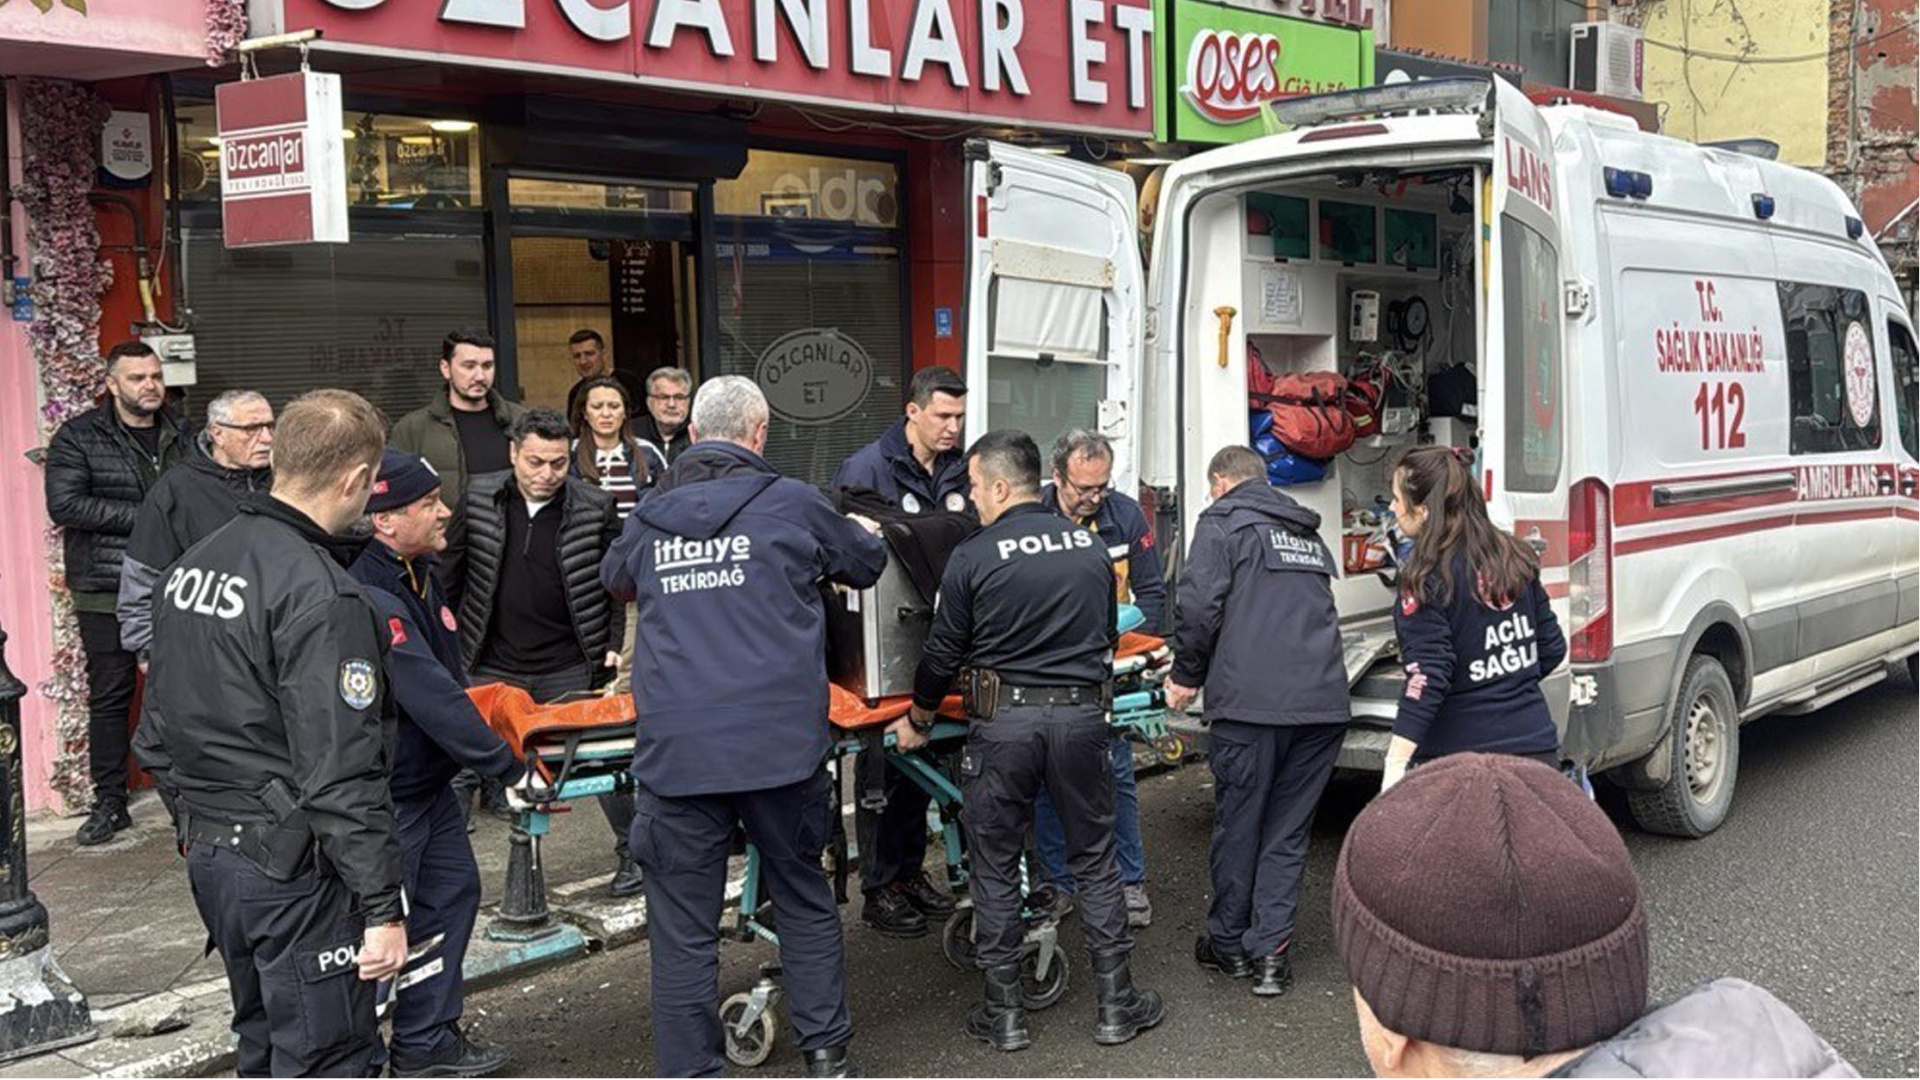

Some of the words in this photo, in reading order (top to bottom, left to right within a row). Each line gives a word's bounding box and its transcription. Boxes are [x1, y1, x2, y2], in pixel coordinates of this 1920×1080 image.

[1070, 0, 1153, 108] ET
[226, 136, 302, 175] özcanlar
[1505, 136, 1552, 211] LANS
[1694, 279, 1723, 322] T.C.
[766, 343, 863, 384] ÖZCANLAR
[1656, 321, 1703, 373] SAĞLIK
[1704, 326, 1765, 373] BAKANLIĞI
[802, 380, 828, 404] ET
[1694, 382, 1745, 451] 112
[1797, 464, 1879, 500] AMBULANS
[997, 529, 1093, 560] POLİS
[660, 563, 745, 594] TEKİRDAĞ
[1484, 612, 1534, 650] ACİL
[1469, 642, 1538, 682] SAĞLI
